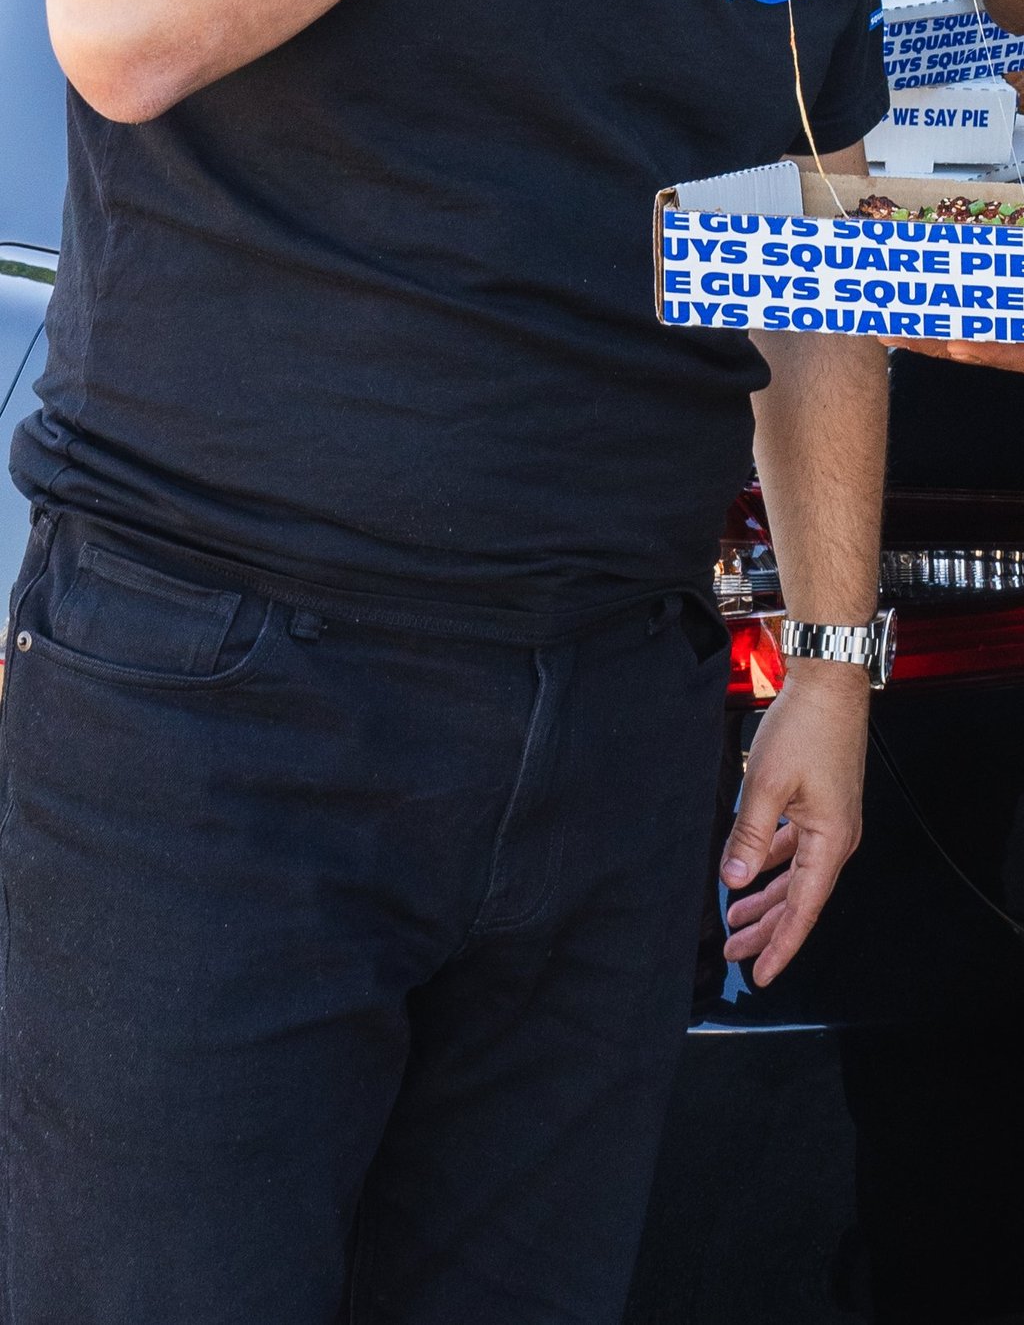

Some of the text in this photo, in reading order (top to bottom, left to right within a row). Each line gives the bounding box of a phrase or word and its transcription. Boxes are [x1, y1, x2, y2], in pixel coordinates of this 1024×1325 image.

[900, 30, 978, 55] SQUARE
[926, 44, 1003, 70] SQUARE
[893, 67, 971, 91] SQUARE
[893, 108, 989, 127] WE SAY PIE
[699, 214, 819, 237] GUYS
[833, 220, 1023, 247] SQUARE
[762, 242, 950, 275] SQUARE
[700, 271, 820, 300] GUYS
[834, 278, 1024, 311] SQUARE
[763, 305, 951, 338] SQUARE
